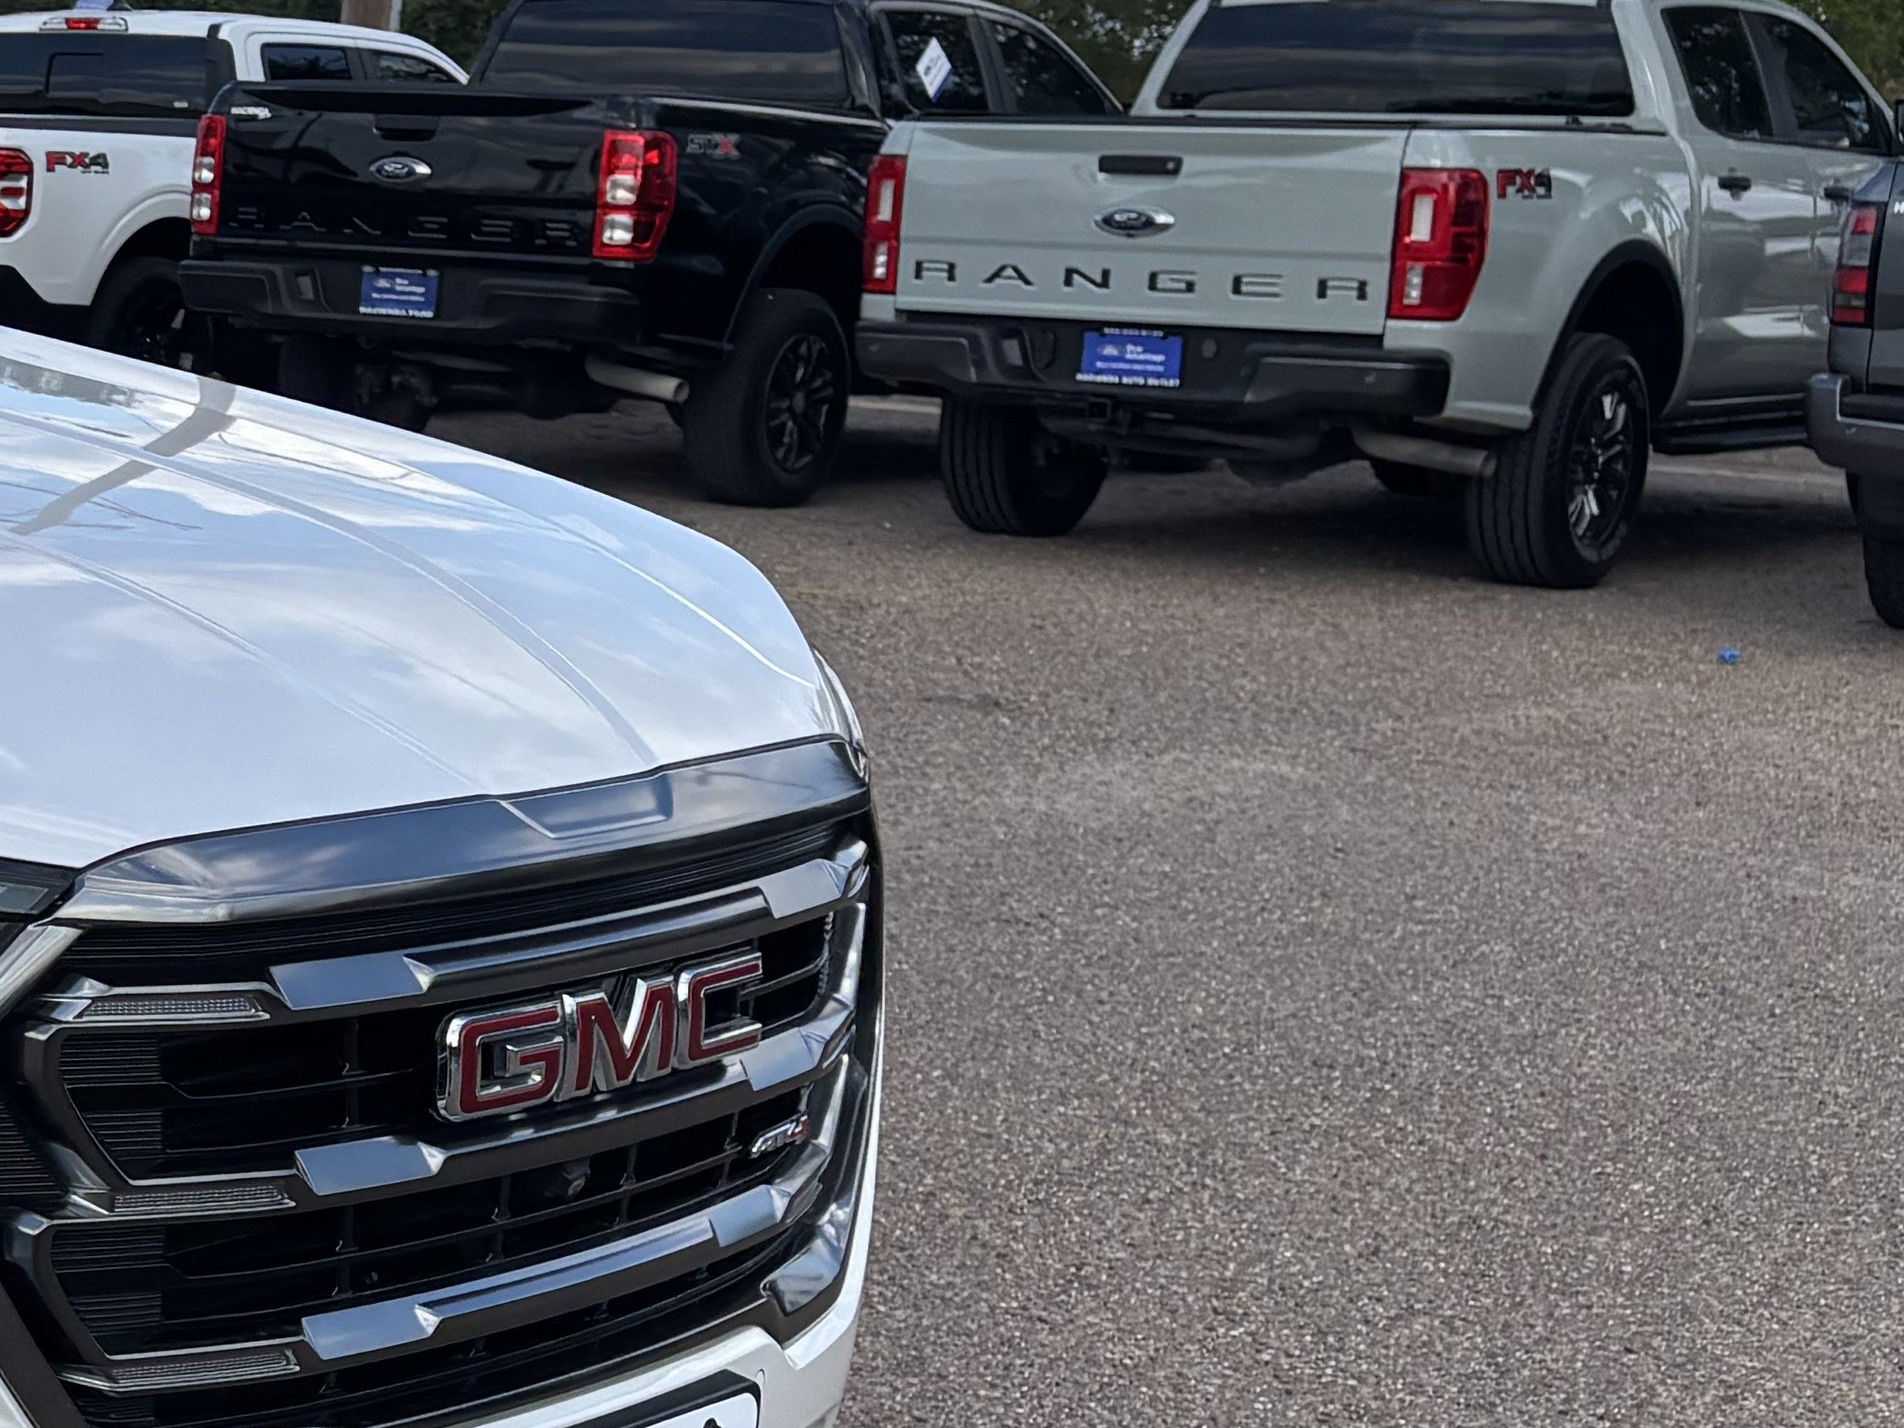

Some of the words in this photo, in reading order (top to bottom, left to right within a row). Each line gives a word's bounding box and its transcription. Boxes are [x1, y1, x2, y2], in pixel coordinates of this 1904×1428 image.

[45, 150, 110, 174] FX4
[1496, 168, 1552, 200] FX4
[913, 259, 1370, 302] RANGER
[436, 952, 764, 1124] GMC
